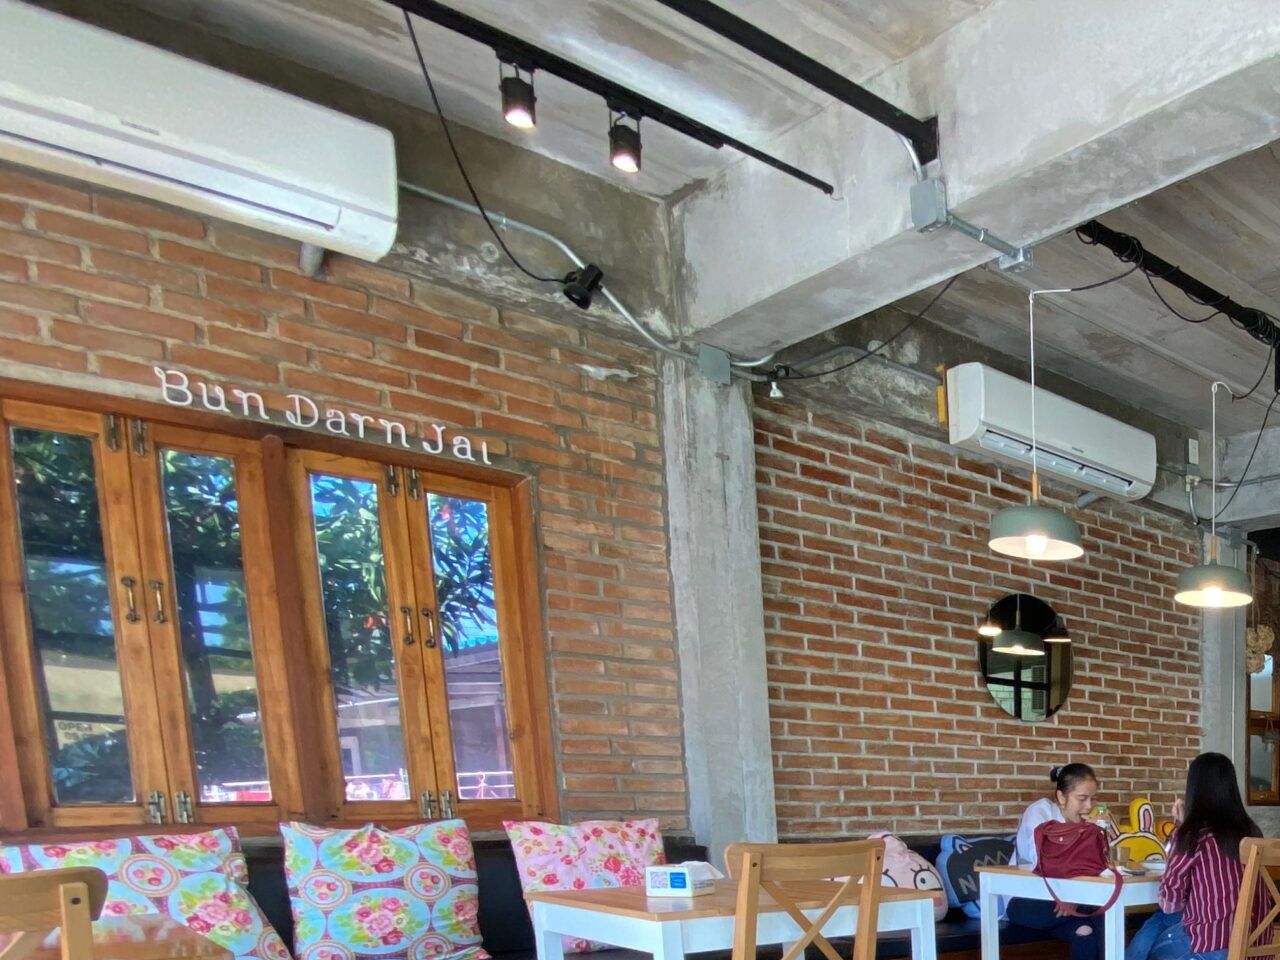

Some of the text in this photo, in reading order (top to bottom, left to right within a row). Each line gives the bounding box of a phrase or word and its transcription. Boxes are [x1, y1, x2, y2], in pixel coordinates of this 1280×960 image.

[154, 366, 492, 465] Bun Darn Jai
